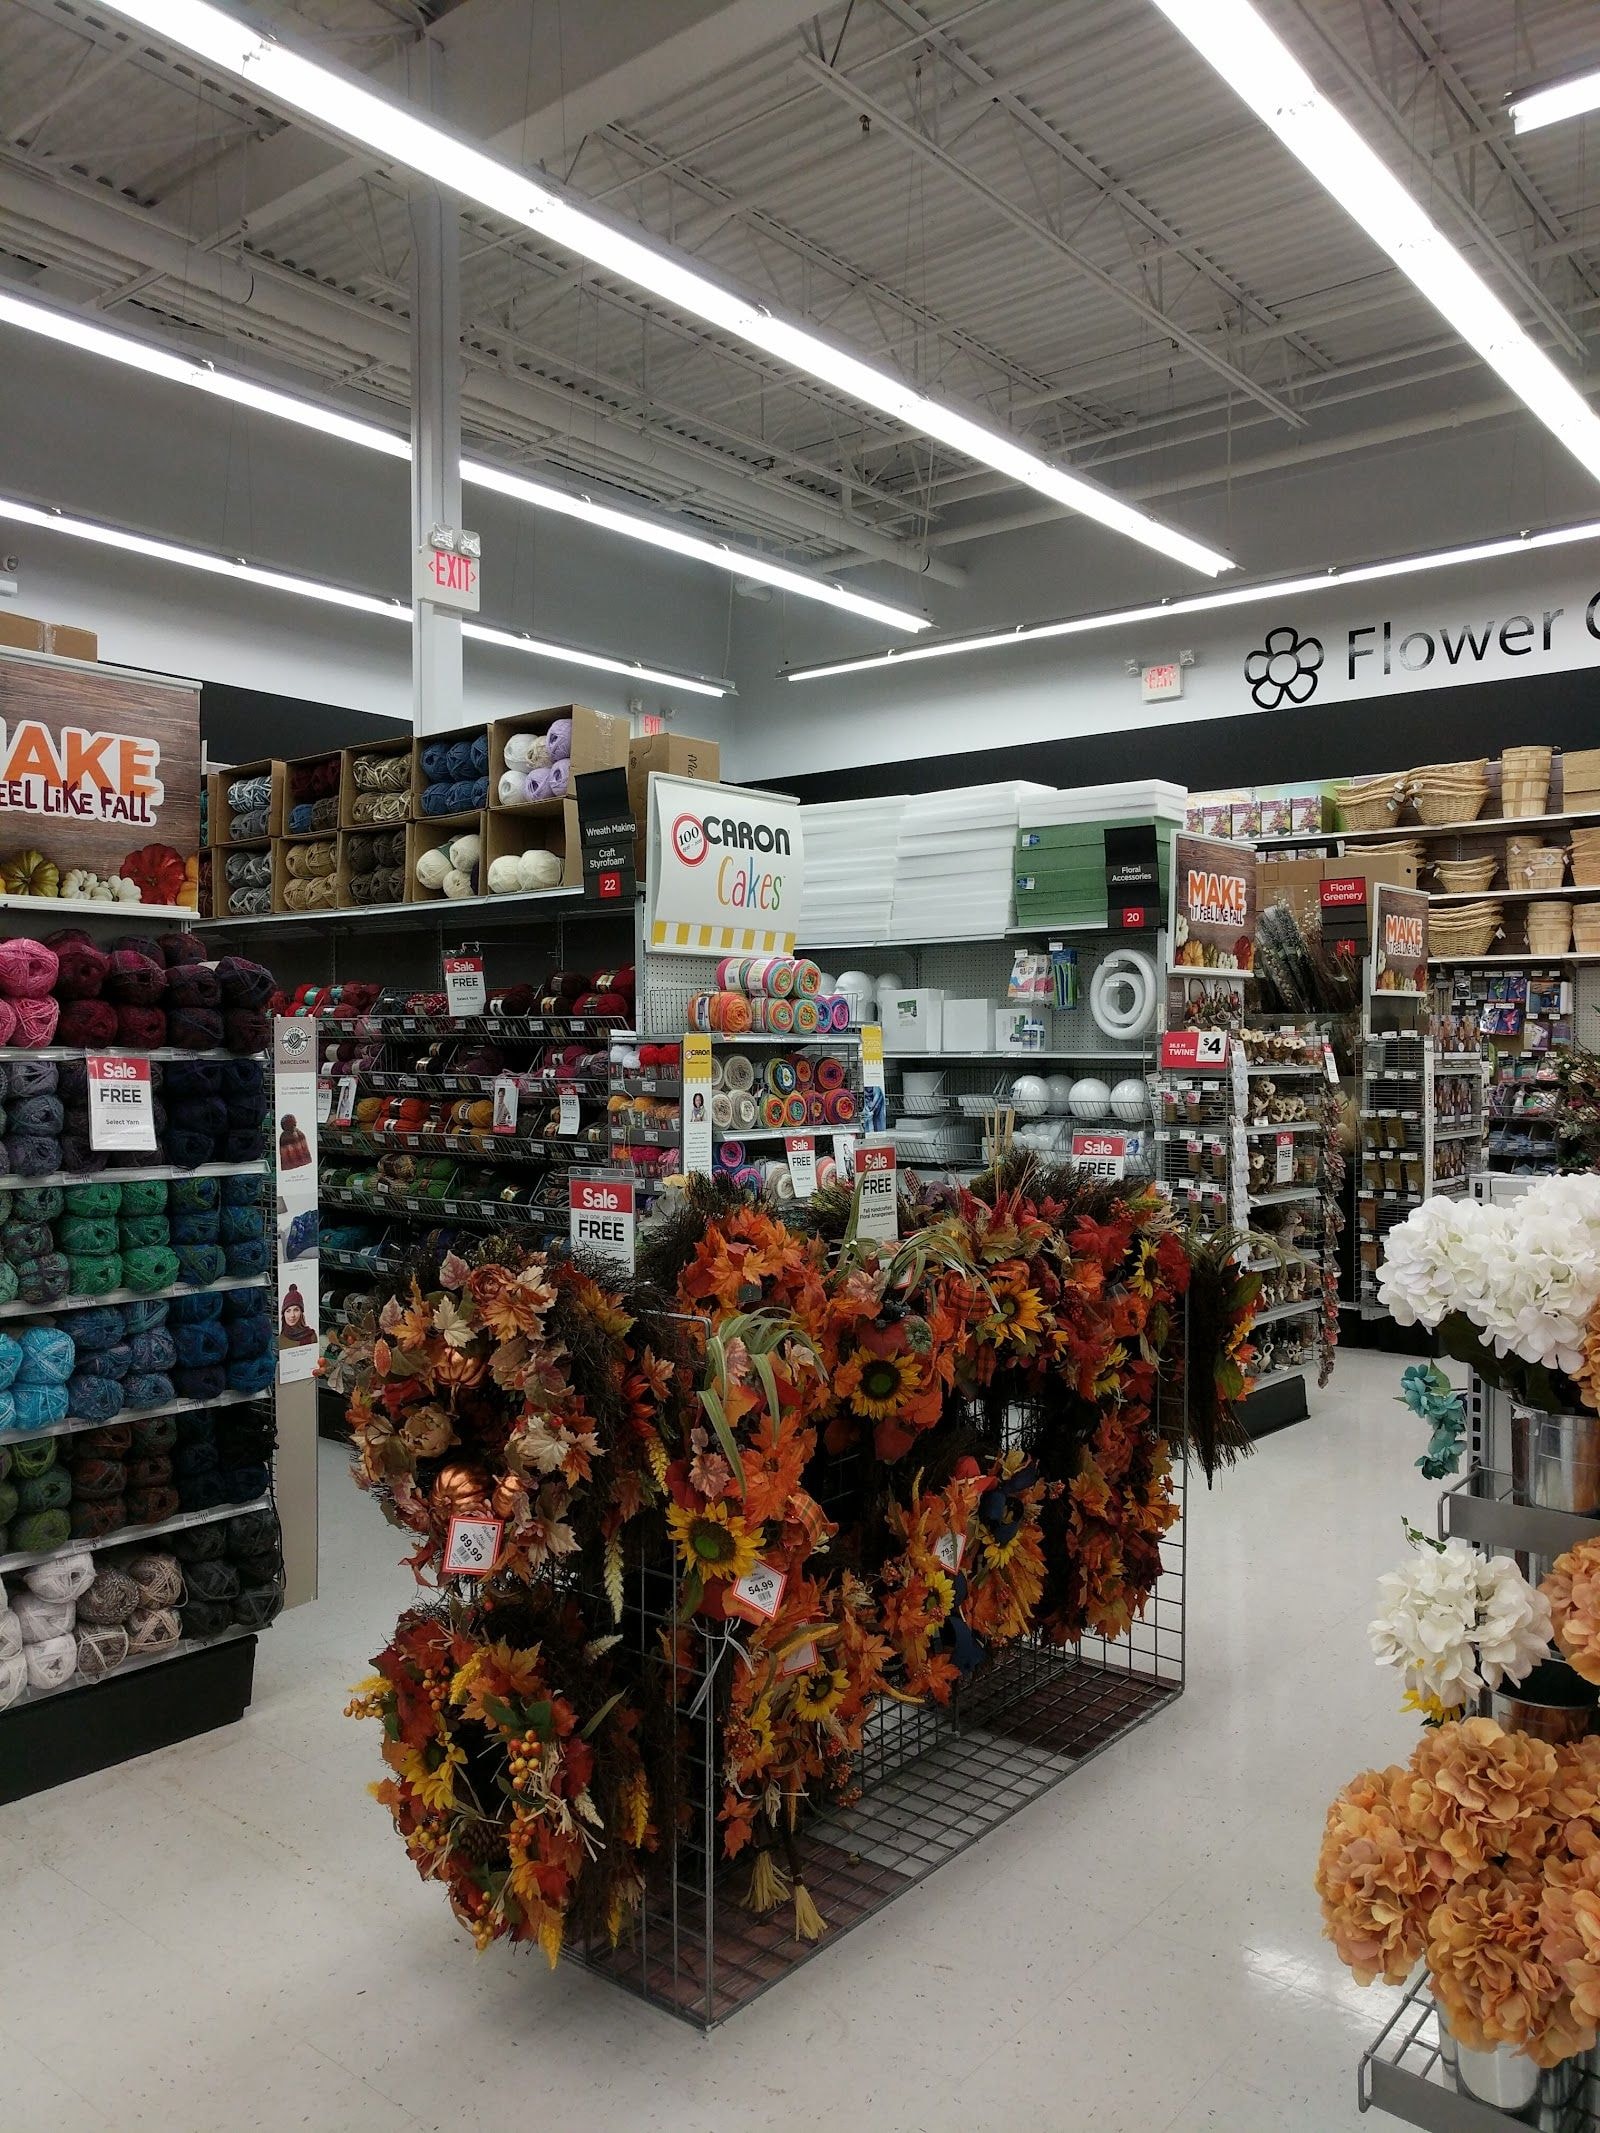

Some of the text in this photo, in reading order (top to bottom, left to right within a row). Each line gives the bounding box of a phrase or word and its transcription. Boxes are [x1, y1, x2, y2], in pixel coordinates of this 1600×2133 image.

[436, 551, 471, 592] EXIT
[1348, 607, 1564, 681] Flower
[644, 714, 662, 735] EXIT
[2, 725, 161, 799] AKE
[0, 779, 38, 809] EEL
[100, 786, 151, 823] FALL
[586, 822, 636, 837] Wreath Making
[678, 826, 699, 846] 100
[703, 815, 790, 857] CARON
[599, 848, 616, 858] Craft
[1112, 873, 1152, 882] Accessories
[1121, 865, 1142, 874] Floral
[604, 879, 616, 891] 22
[717, 855, 782, 911] Cakes
[1189, 872, 1245, 911] MAKE
[1330, 882, 1355, 892] Floral
[1323, 891, 1363, 901] Greenery
[1126, 912, 1140, 922] 20
[1386, 916, 1422, 945] MAKE
[453, 961, 475, 972] Sale
[452, 977, 479, 988] FREE
[1168, 1048, 1196, 1056] TWINE
[1203, 1037, 1222, 1055] $4
[103, 1062, 137, 1079] Sale
[100, 1088, 142, 1103] FREE
[791, 1139, 809, 1151] Sale
[1083, 1140, 1113, 1155] Sale
[791, 1156, 812, 1167] FREE
[864, 1152, 888, 1169] Sale
[1078, 1161, 1116, 1176] FREE
[862, 1177, 892, 1196] FREE
[582, 1187, 619, 1210] Sale
[578, 1219, 625, 1242] FREE
[459, 1533, 483, 1562] 89.99
[747, 1579, 774, 1596] 54.99
